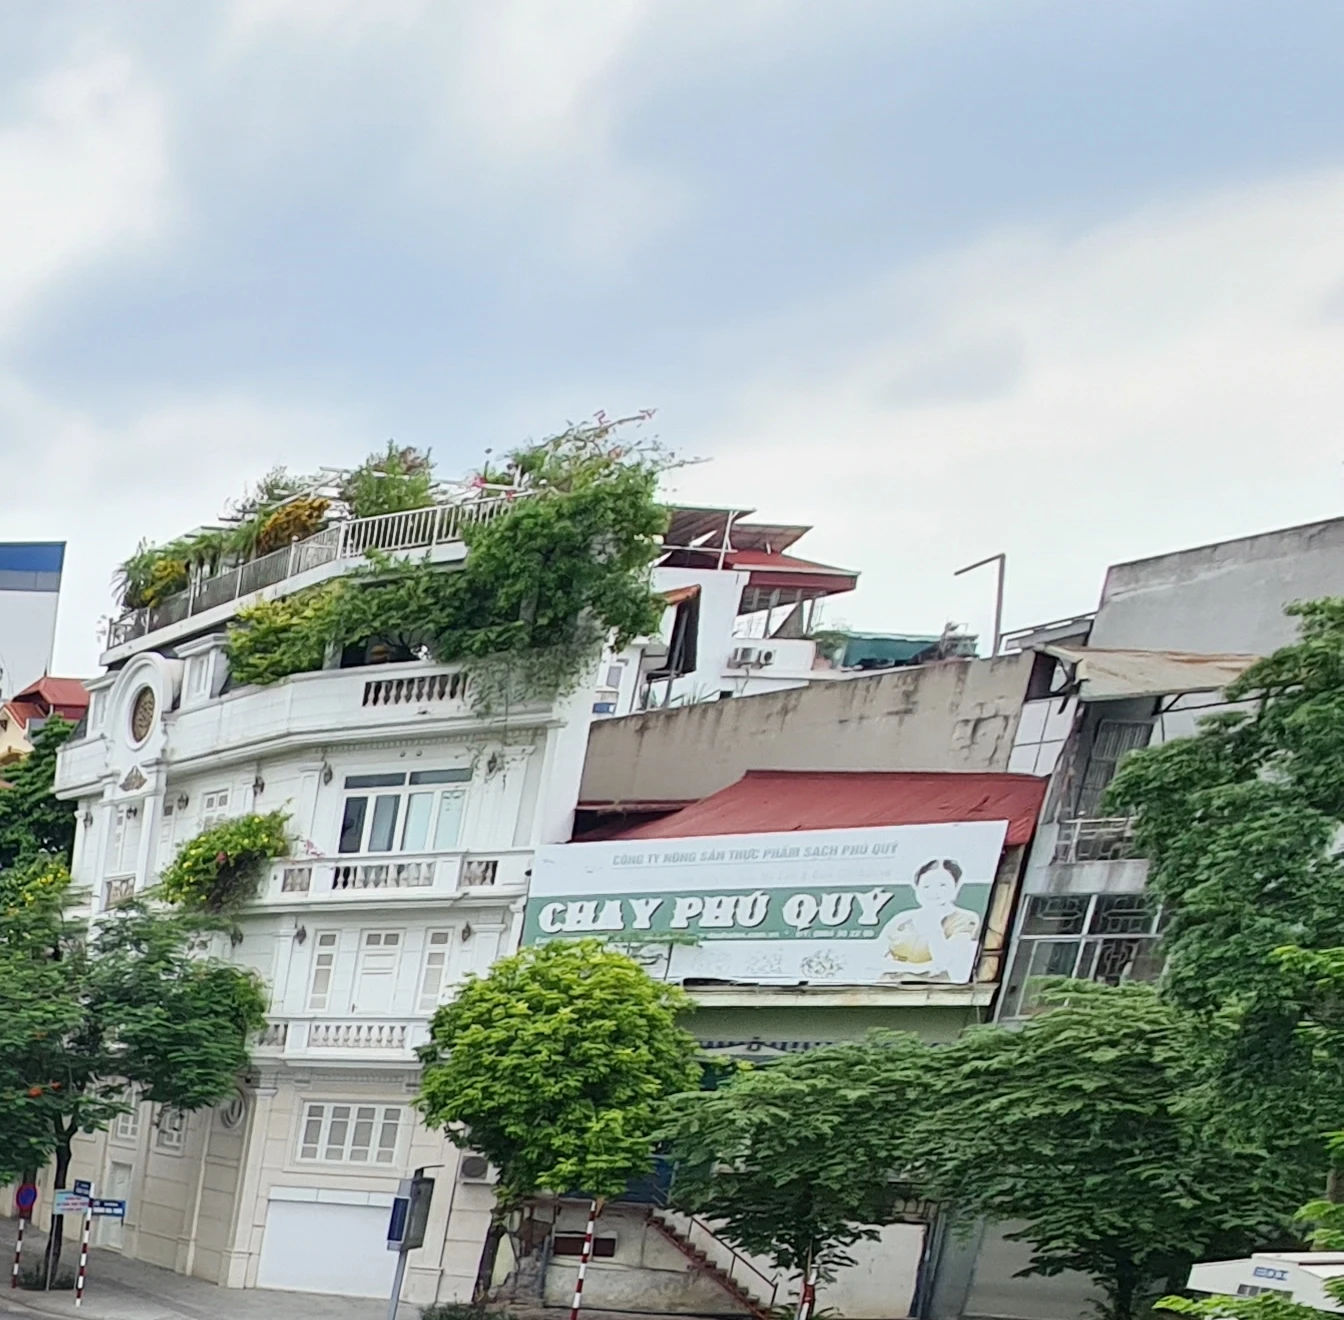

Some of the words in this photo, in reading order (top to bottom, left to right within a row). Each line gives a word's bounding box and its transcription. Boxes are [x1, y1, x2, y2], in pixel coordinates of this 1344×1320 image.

[612, 852, 645, 866] CÔNG
[647, 852, 663, 865] TY
[664, 850, 696, 864] NÔNG
[538, 897, 664, 933] CHAY
[670, 889, 771, 930] PHÚ
[782, 887, 895, 932] QUÝ
